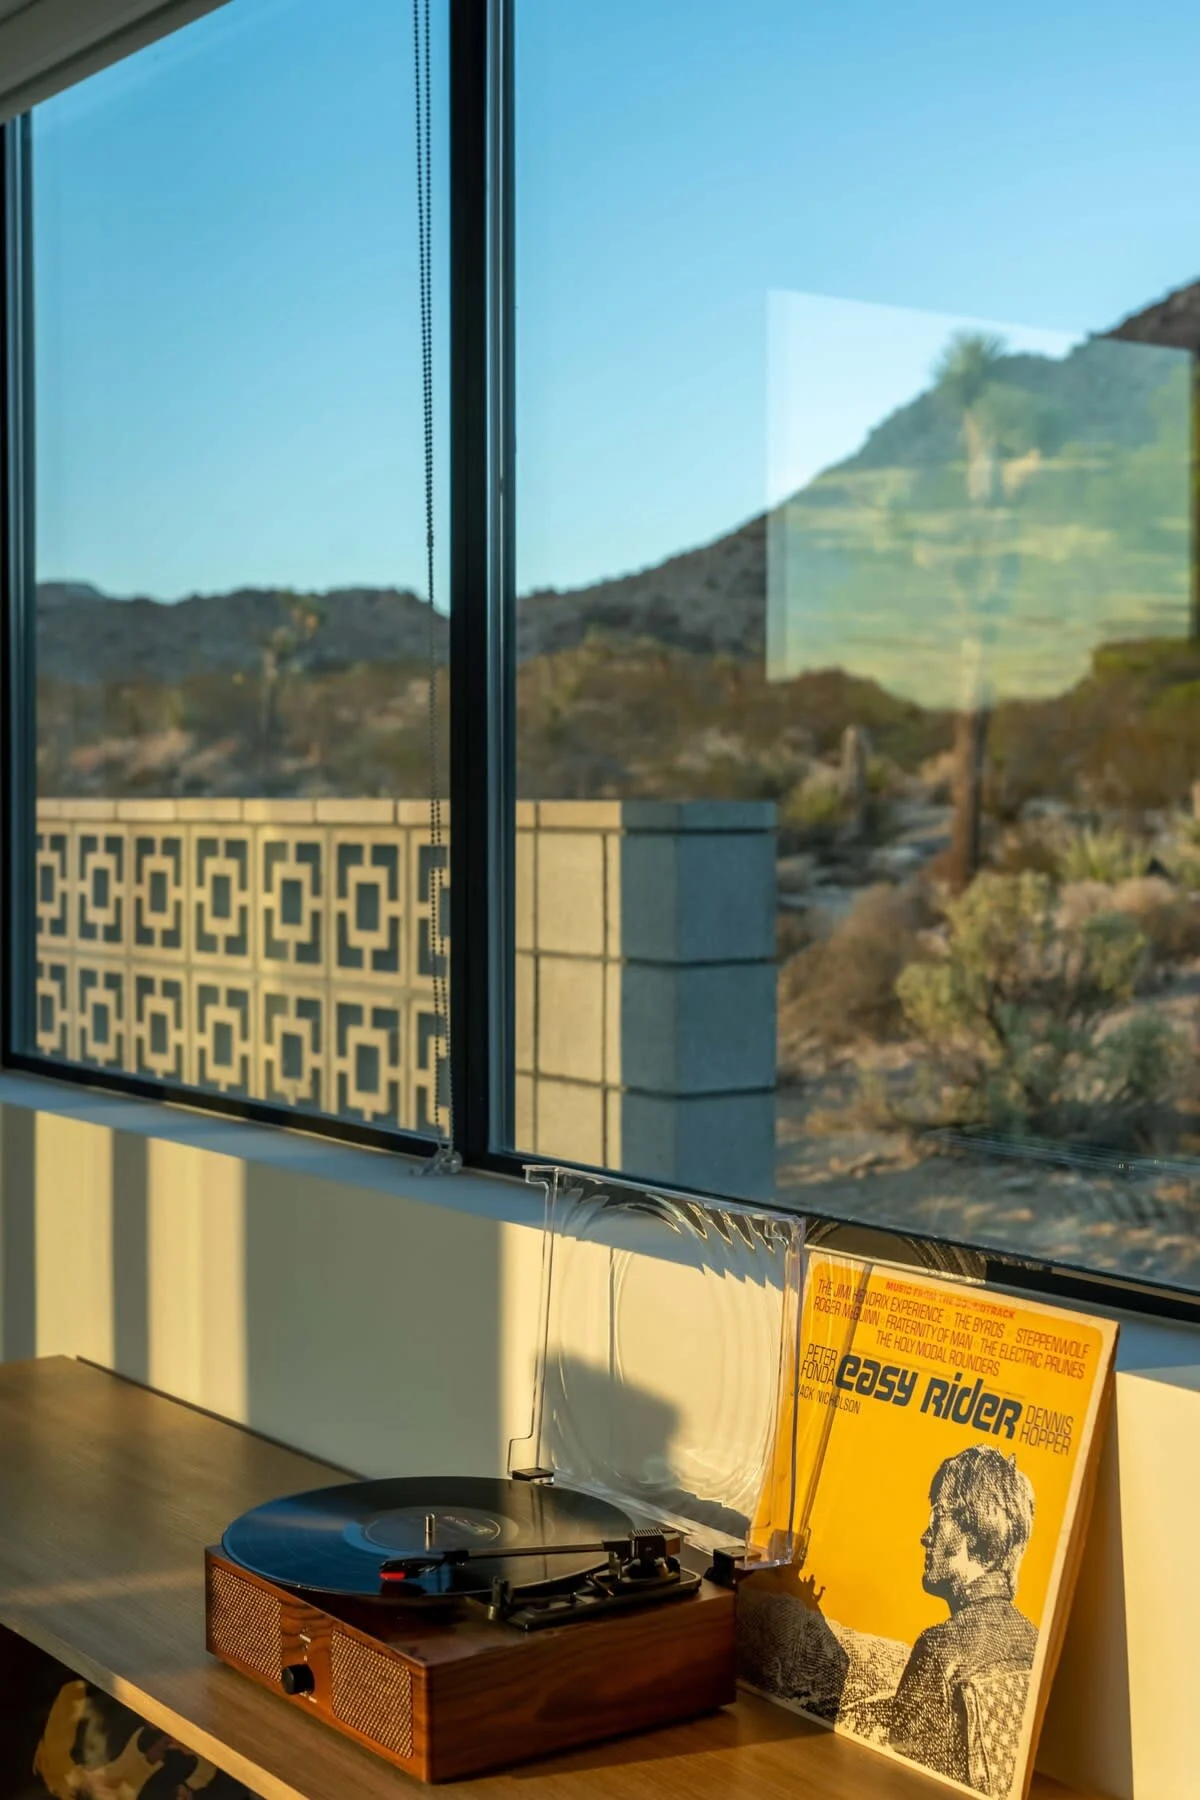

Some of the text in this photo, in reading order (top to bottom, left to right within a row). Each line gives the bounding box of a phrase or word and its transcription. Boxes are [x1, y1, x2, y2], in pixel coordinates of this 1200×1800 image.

[886, 1281, 912, 1295] MUSIC
[954, 1298, 1016, 1319] SODTRACK
[818, 1279, 832, 1296] THE
[834, 1283, 851, 1300] JIMI
[890, 1296, 944, 1323] EXPERIENCE
[954, 1312, 972, 1331] THE
[972, 1317, 1005, 1339] BYRDS
[1016, 1328, 1090, 1359] STEPPENWOLF
[806, 1343, 838, 1366] PETER
[814, 1296, 841, 1315] ROGER
[885, 1314, 937, 1339] FRATERNITY
[936, 1328, 949, 1343] OF
[949, 1331, 973, 1350] MAN
[980, 1338, 998, 1357] THE
[999, 1343, 1043, 1368] ELECTRIC
[1044, 1354, 1085, 1380] PRUNES
[876, 1330, 1000, 1376] THE HOLY MODAL ROUNDERS
[801, 1360, 835, 1386] FONDA
[836, 1354, 918, 1407] easy
[817, 1390, 860, 1414] NICHOLSON
[1025, 1404, 1073, 1435] DENNIS
[1019, 1423, 1071, 1456] HOPPER
